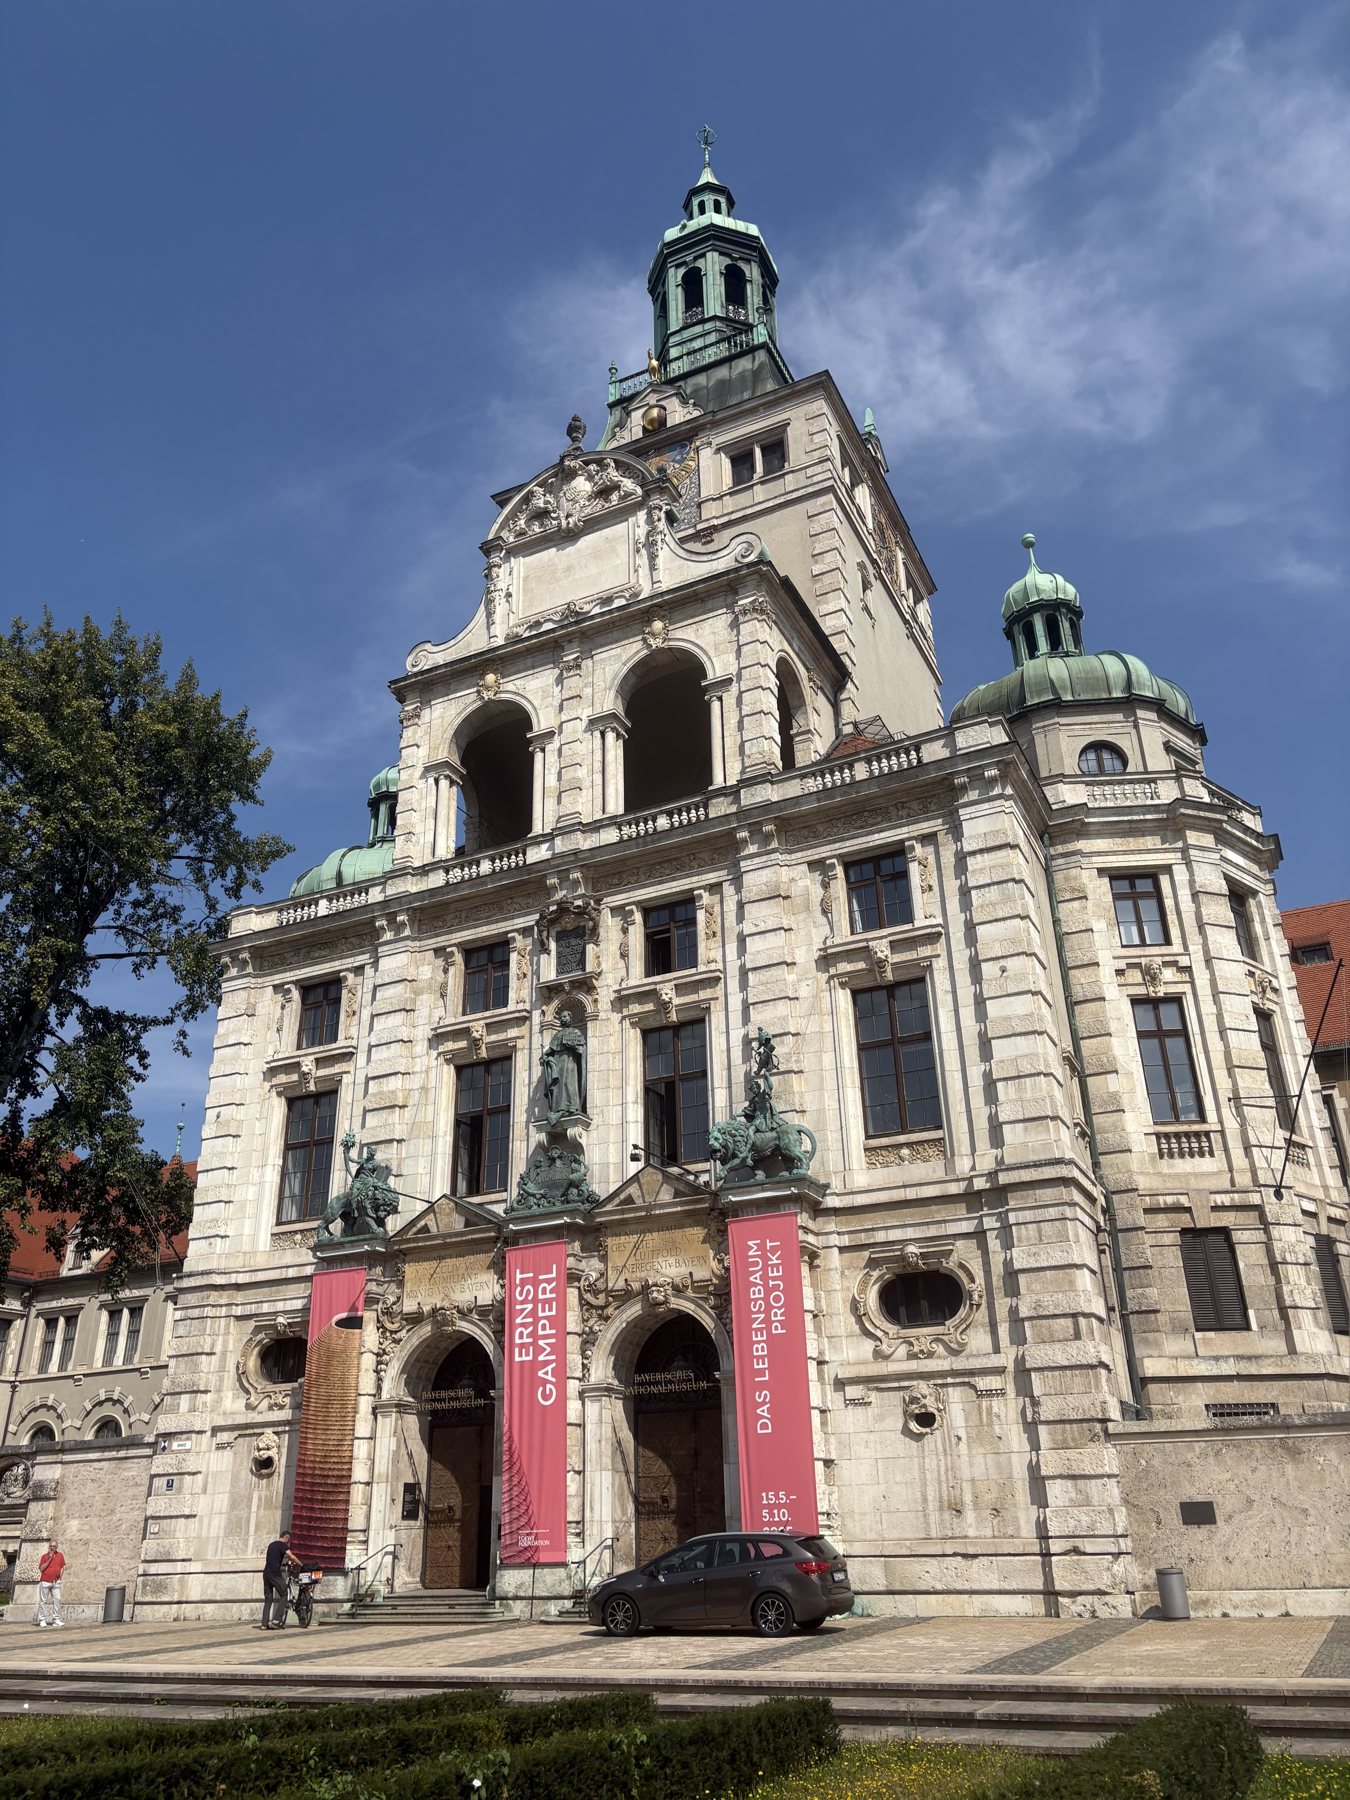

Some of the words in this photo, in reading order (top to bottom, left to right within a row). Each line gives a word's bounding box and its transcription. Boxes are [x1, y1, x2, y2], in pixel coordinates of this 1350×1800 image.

[634, 1246, 682, 1262] LUITPOLD
[674, 1255, 708, 1269] BAYERN
[460, 1280, 490, 1294] BAYERN
[766, 1239, 787, 1334] PROJEKT
[514, 1268, 534, 1362] ERNST
[747, 1239, 769, 1382] LEBENSBAUM
[537, 1263, 557, 1406] GAMPERL
[634, 1369, 693, 1383] BAYERISCHES
[421, 1387, 474, 1400] BAYERISCHES
[622, 1380, 707, 1396] NATIONALMUSEUM
[410, 1398, 484, 1412] NATIONALMUSEUM
[755, 1390, 772, 1434] DAS
[762, 1508, 792, 1522] 5.10.
